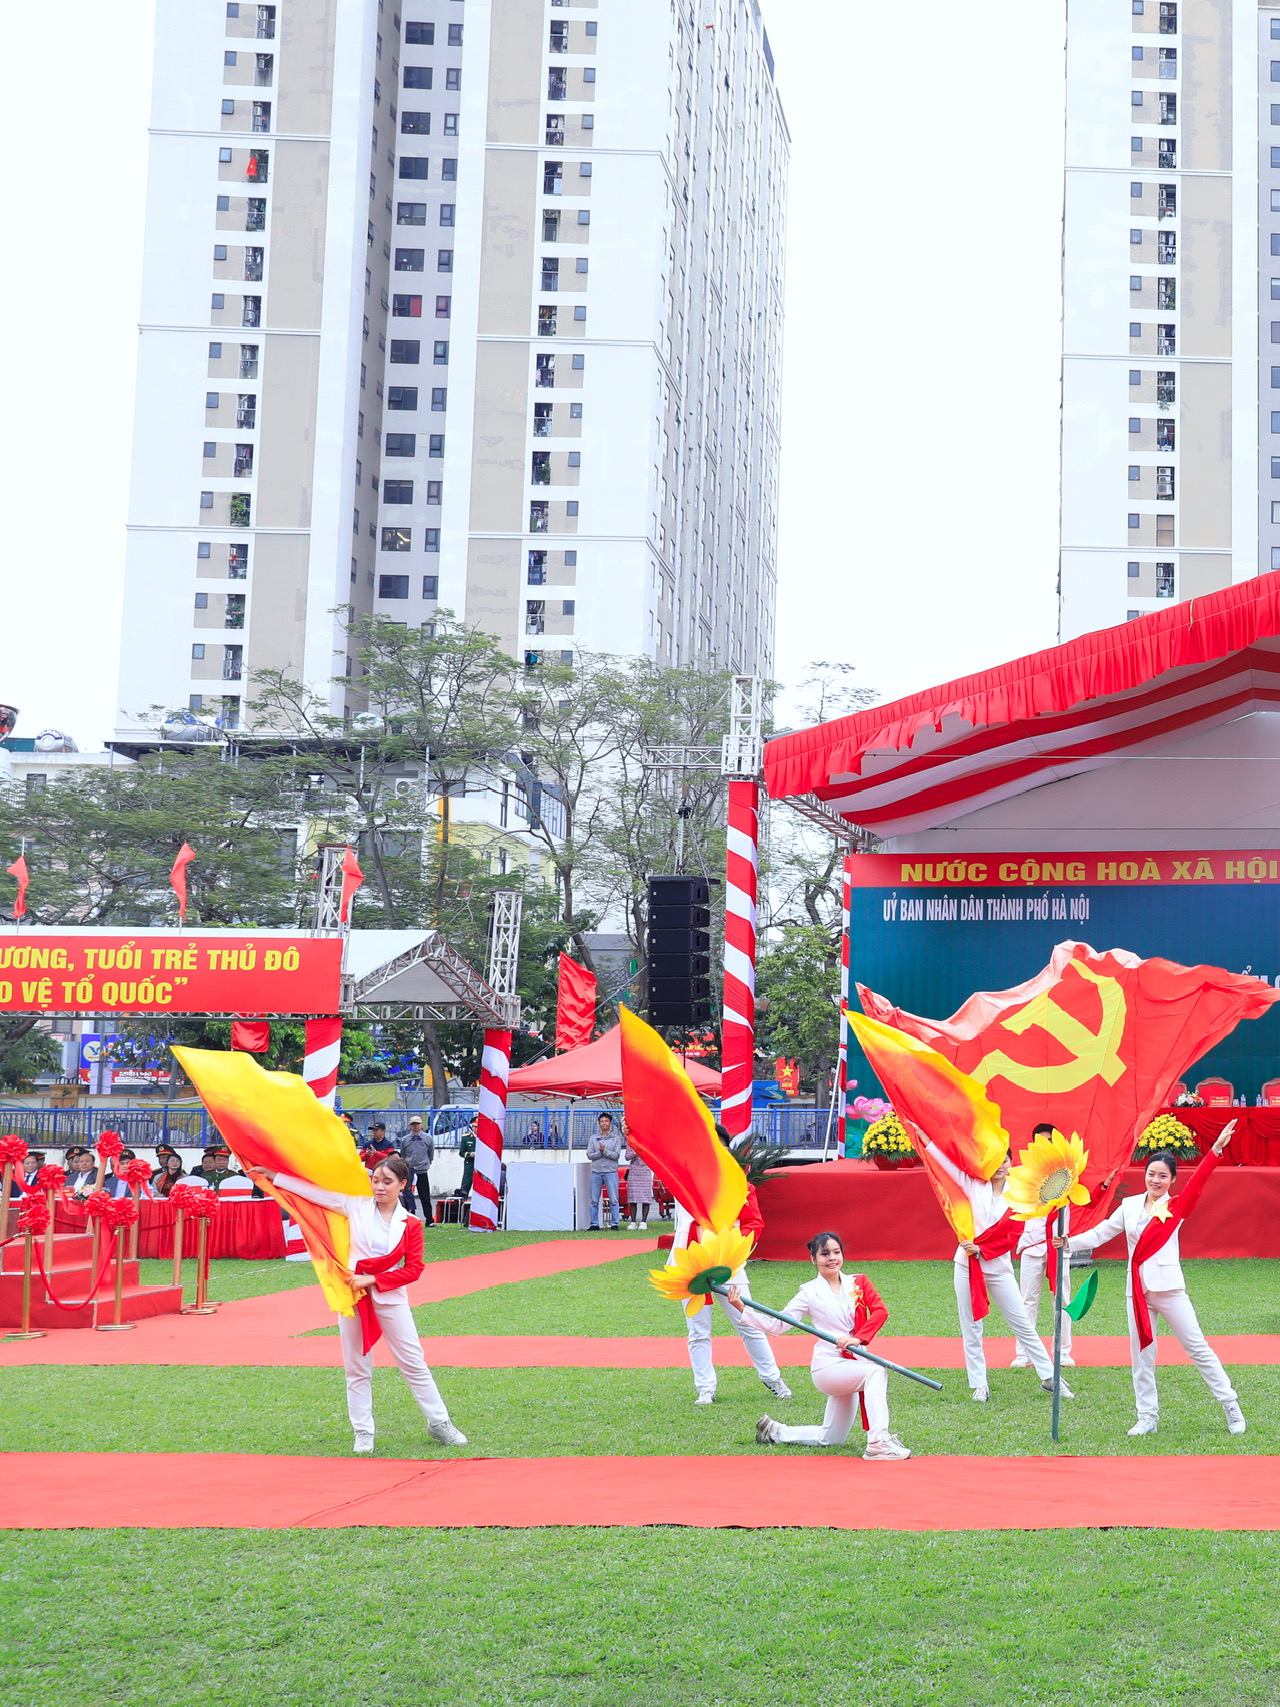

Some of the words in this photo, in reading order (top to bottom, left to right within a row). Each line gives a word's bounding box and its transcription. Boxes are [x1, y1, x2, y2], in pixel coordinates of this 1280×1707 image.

[900, 859, 987, 882] NƯỚC
[999, 858, 1086, 886] CỘNG
[1097, 857, 1161, 881] HOÀ
[1172, 857, 1215, 881] XÃ
[1226, 856, 1278, 884] HỘI
[883, 891, 898, 922] UỶ
[900, 898, 924, 921] BAN
[926, 894, 958, 921] NHÂN
[960, 894, 984, 921] DÂN
[986, 893, 1024, 921] THÀNH
[1026, 890, 1050, 921] PHỐ
[1051, 893, 1068, 920] HÀ
[1069, 893, 1090, 925] NỘI
[84, 940, 142, 970] TUỔI
[151, 942, 198, 971] TRẺ
[207, 943, 257, 971] THỦ
[264, 946, 301, 972] ĐÔ
[21, 976, 53, 1008] VỆ
[61, 973, 95, 1004] TỔ
